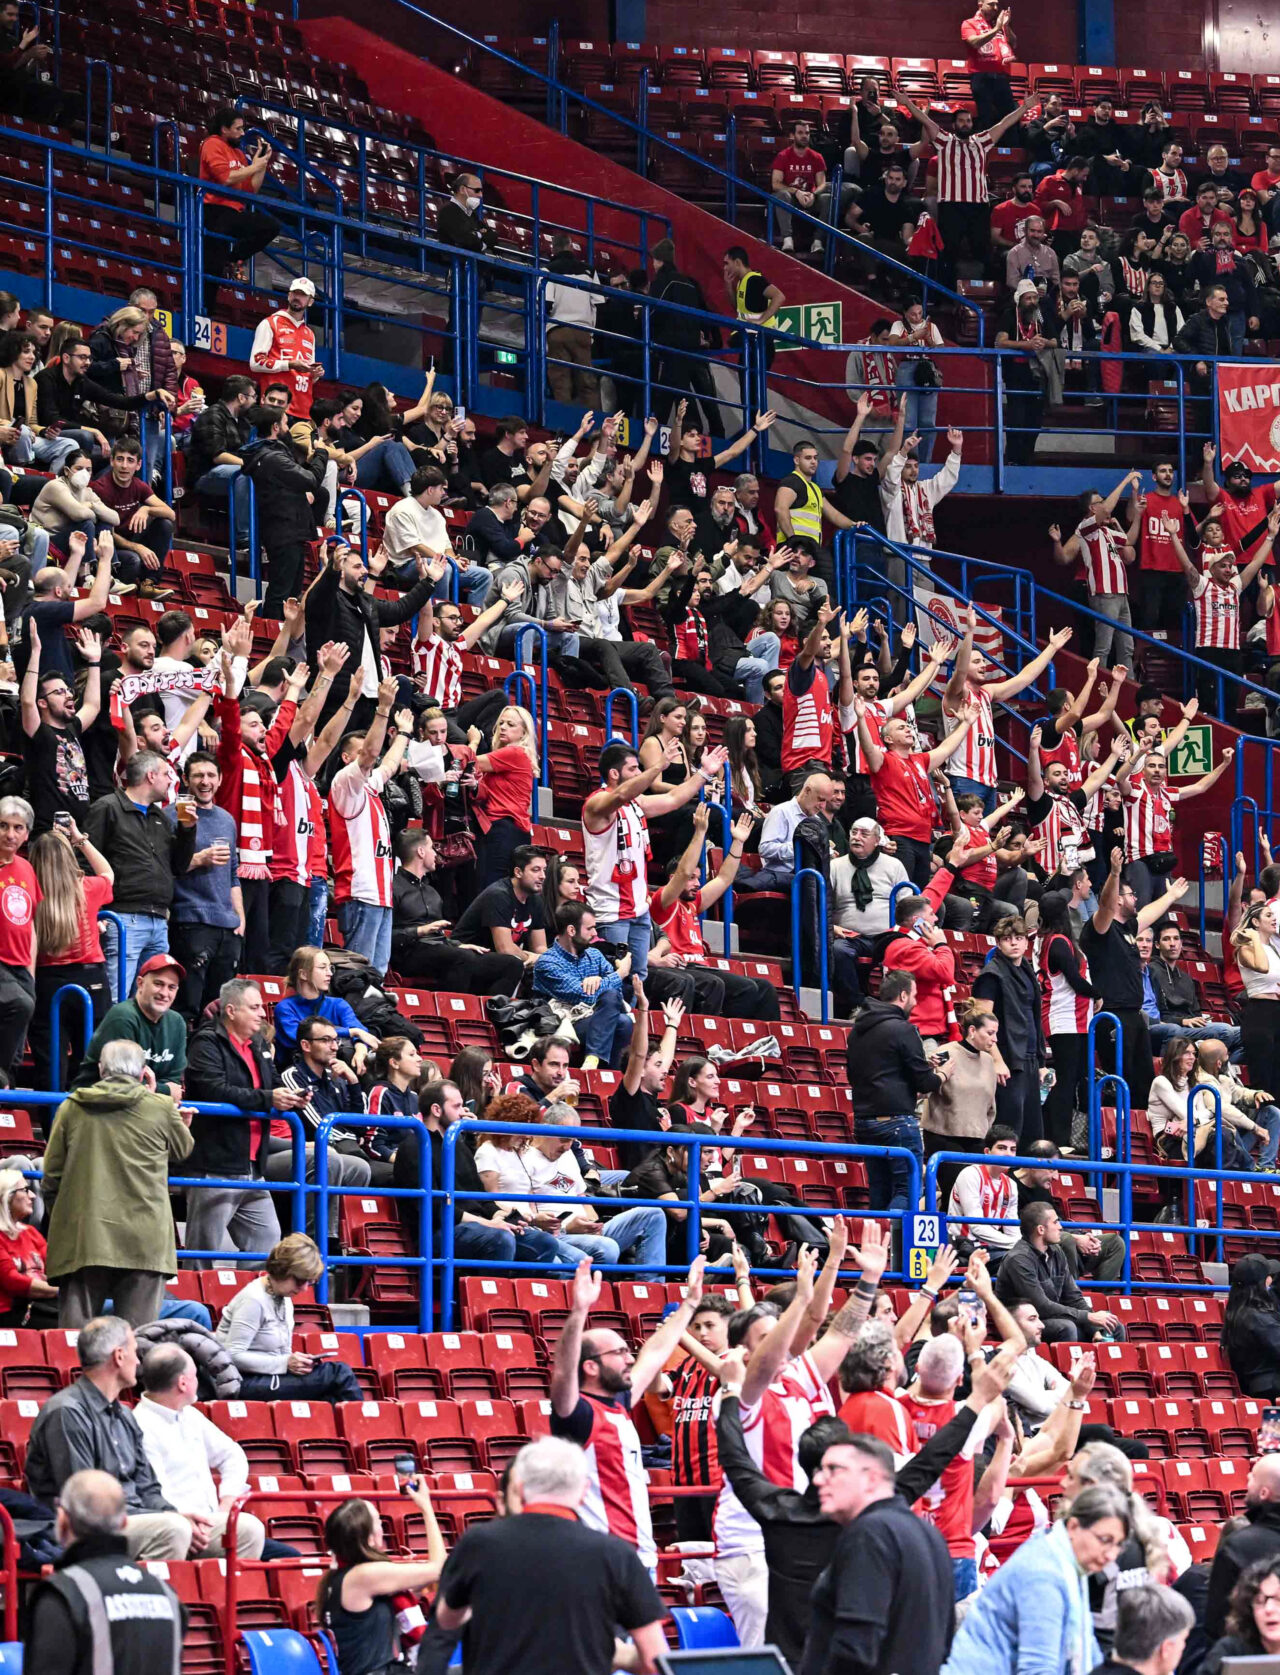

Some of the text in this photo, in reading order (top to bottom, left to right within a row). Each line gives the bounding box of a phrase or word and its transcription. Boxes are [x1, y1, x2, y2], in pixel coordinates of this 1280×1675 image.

[158, 312, 167, 328] B
[195, 322, 210, 345] 24
[213, 339, 222, 353] C
[295, 375, 308, 393] 35
[918, 1219, 935, 1242] 23
[914, 1262, 922, 1276] B
[630, 1450, 638, 1464] 7
